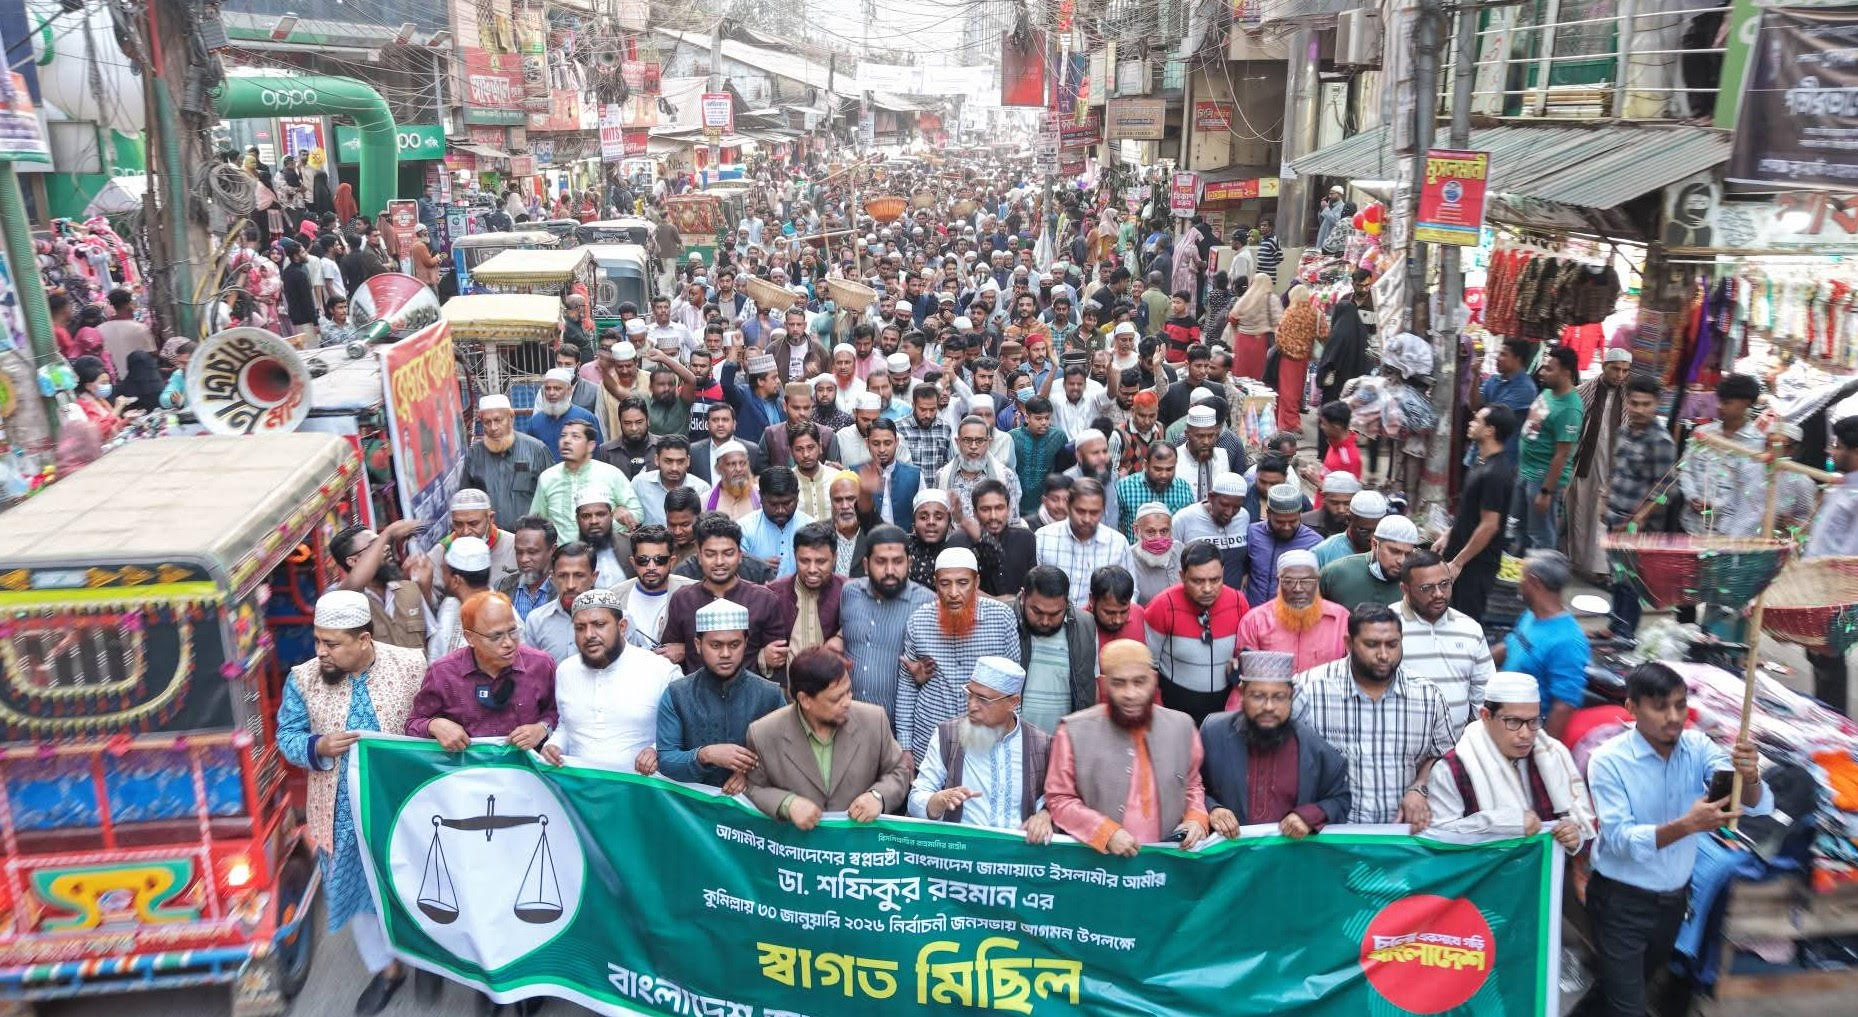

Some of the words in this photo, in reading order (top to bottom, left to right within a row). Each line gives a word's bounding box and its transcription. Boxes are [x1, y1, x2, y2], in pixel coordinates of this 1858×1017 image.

[261, 89, 318, 110] oppo
[715, 823, 765, 851] আগামীর
[767, 839, 845, 866] বাংলাদেশের
[849, 848, 901, 868] স্বপ্নদ্রষ্টা
[903, 851, 973, 874] বাংলাদেশ
[976, 860, 1046, 879] জামায়াতে
[1049, 862, 1119, 889] ইসলামীর
[703, 887, 755, 915] কুমিল্লায়
[757, 904, 778, 920] ৩০
[780, 909, 841, 931] জানুয়ারি
[844, 916, 885, 932] ২০২৬
[889, 911, 947, 935] নির্বাচনী
[950, 915, 1017, 932] জনসভায়
[1020, 922, 1073, 941] আগমন
[1076, 927, 1136, 951] উপলক্ষে
[777, 867, 810, 896] ডা.
[816, 868, 921, 912] শফিকুর
[927, 876, 1018, 909] রহমান
[1022, 892, 1055, 911] এর
[756, 941, 899, 999] স্বাগত
[915, 936, 1083, 1016] মিছিল
